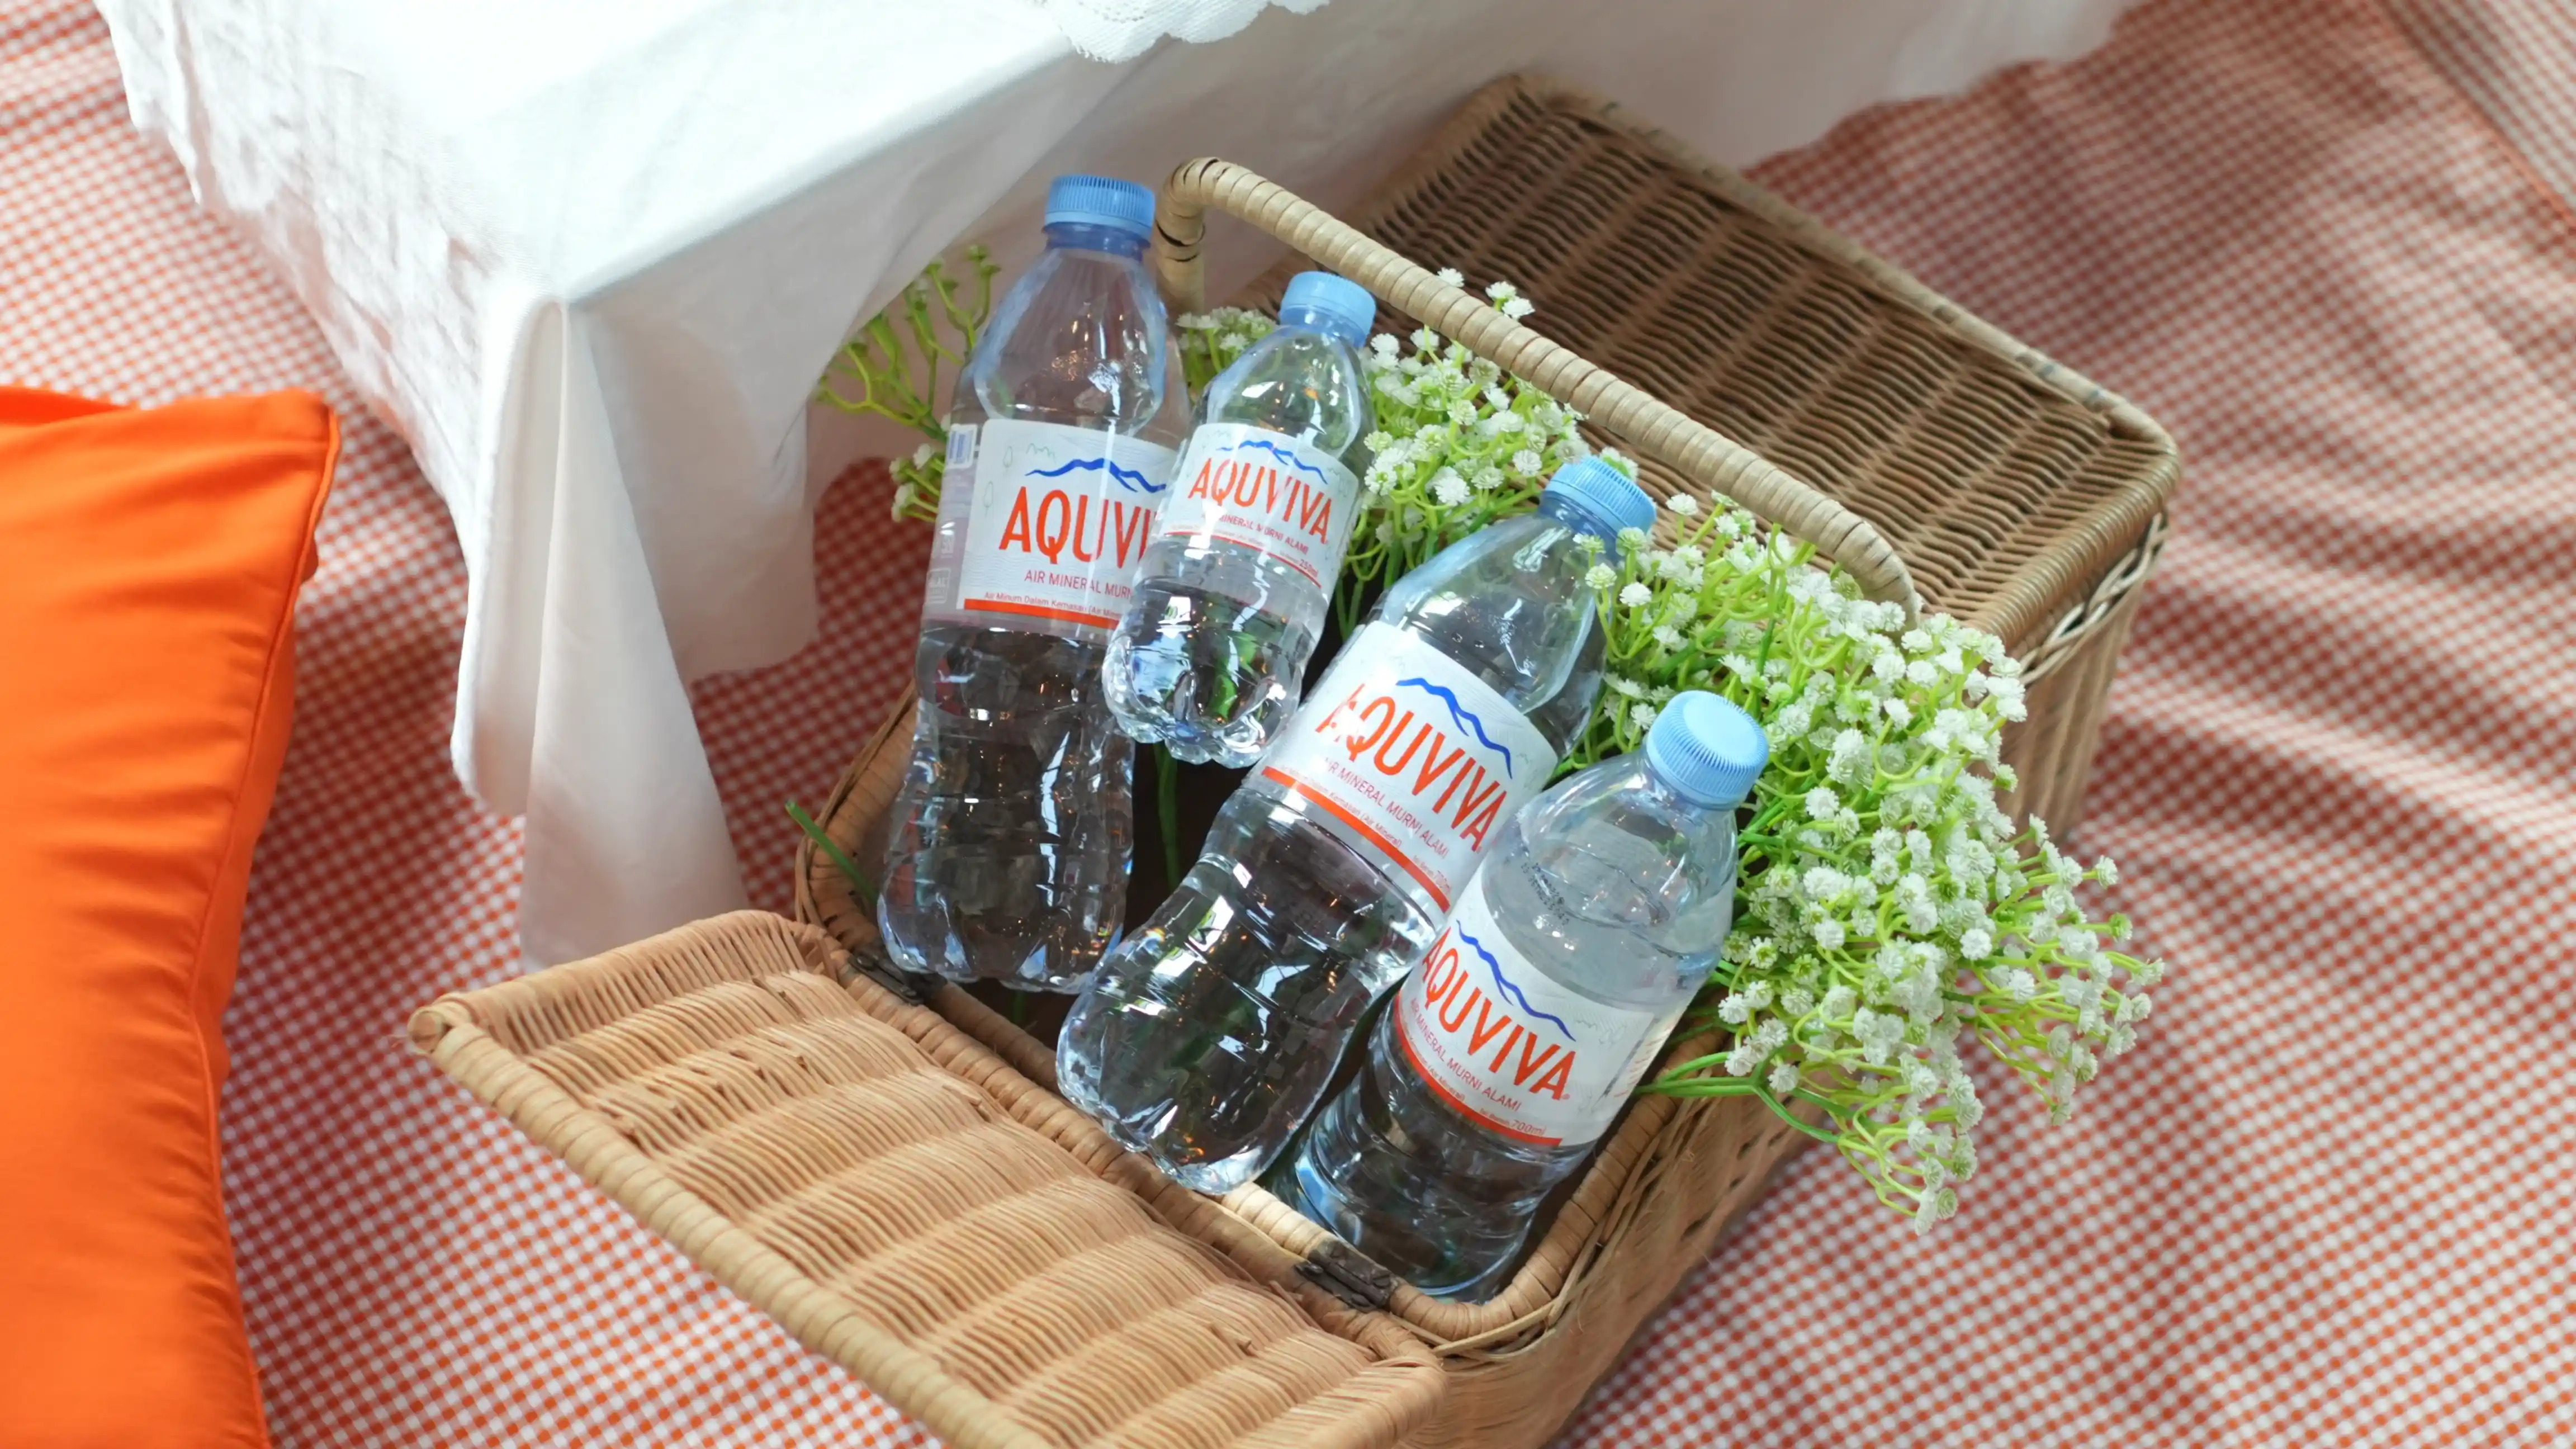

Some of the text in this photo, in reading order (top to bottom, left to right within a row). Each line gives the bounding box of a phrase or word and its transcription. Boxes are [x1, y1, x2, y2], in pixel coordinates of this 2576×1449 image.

[999, 486, 1157, 569] AQUVI
[1188, 458, 1332, 544] AQUVIVA
[1024, 570, 1133, 600] AIR MINERAL MURN
[1285, 537, 1309, 555] ALAMI
[1337, 768, 1385, 807] MINERAL
[1386, 801, 1423, 835] MURNI
[1419, 830, 1450, 860] ALAMI
[1422, 926, 1576, 1100] AQUVIVA
[1415, 1014, 1447, 1062] MINERAL
[1446, 1058, 1483, 1090] MURNI
[1481, 1086, 1522, 1112] ALAMI
[1512, 1119, 1547, 1137] 700ml
